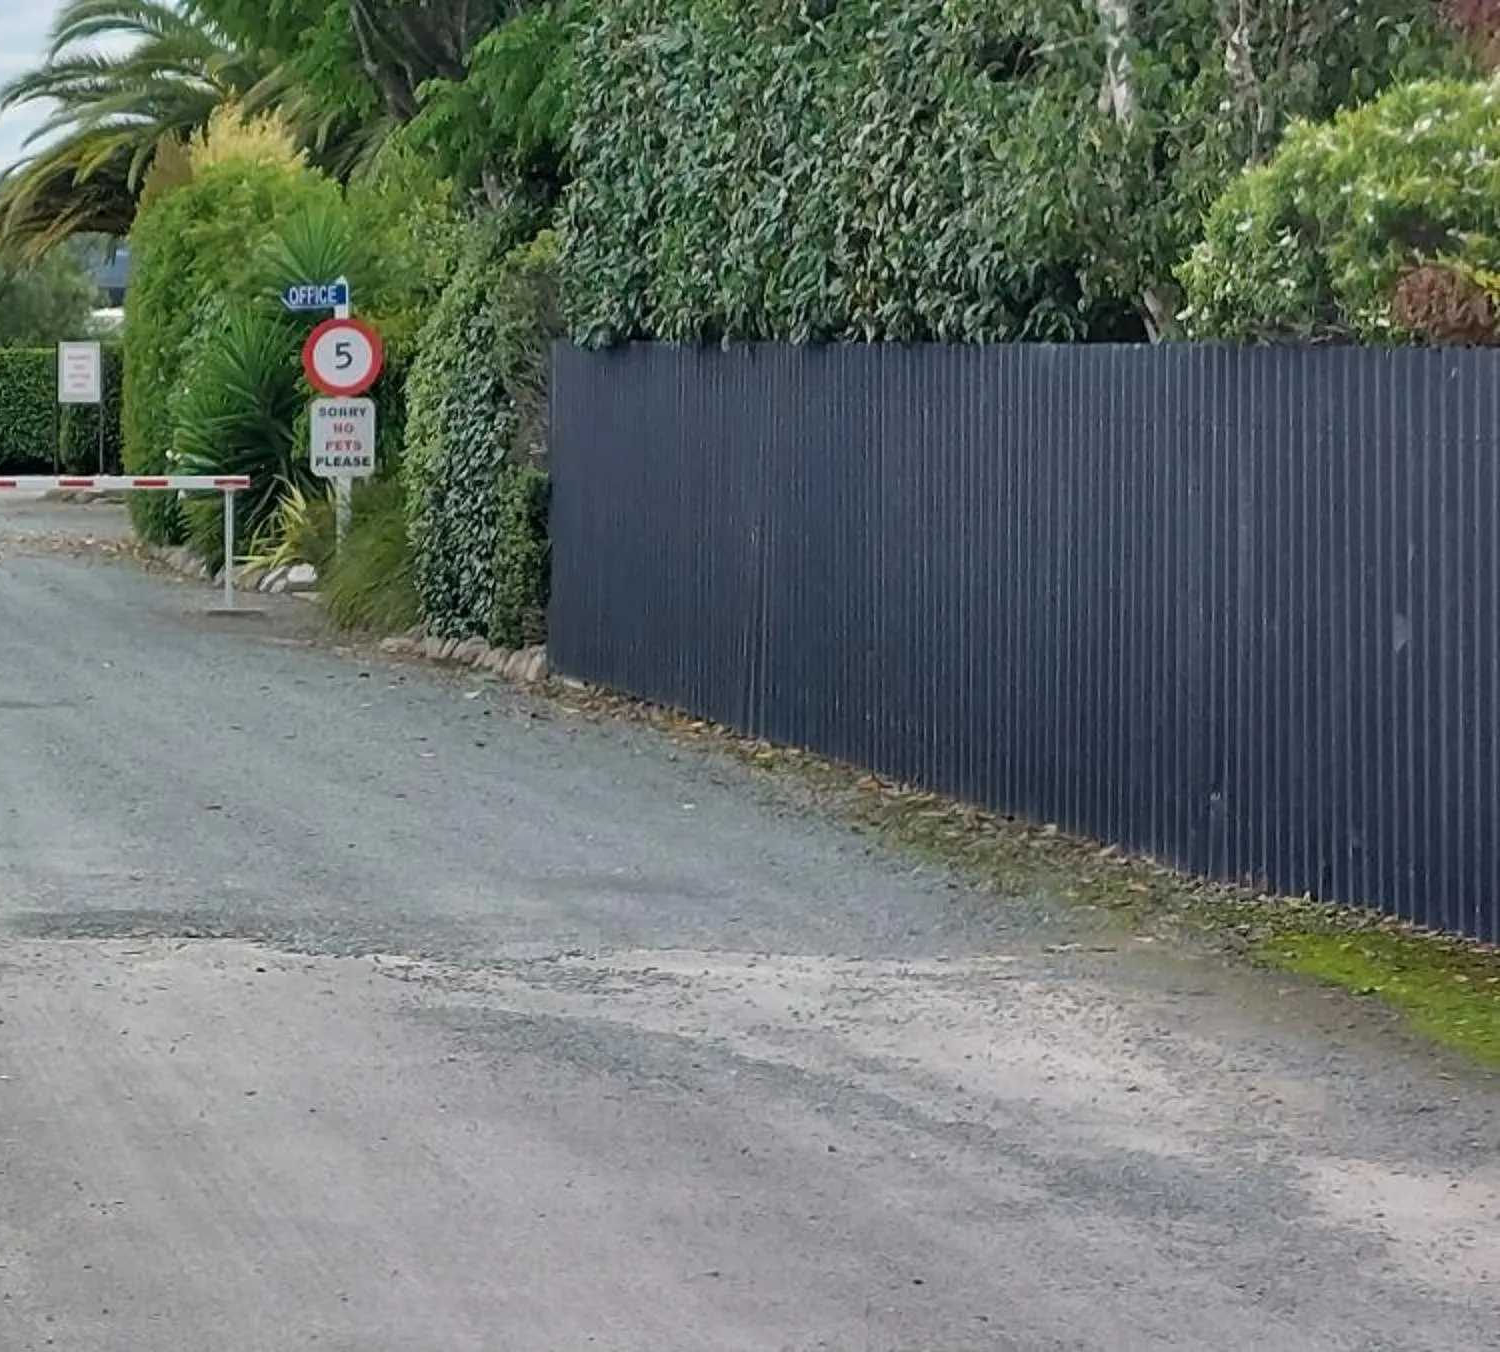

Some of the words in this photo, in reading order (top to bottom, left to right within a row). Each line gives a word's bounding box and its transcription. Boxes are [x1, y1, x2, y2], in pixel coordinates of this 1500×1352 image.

[289, 286, 337, 304] OFFICE
[335, 342, 353, 369] 5
[318, 406, 367, 417] SORRY
[333, 422, 355, 434] NO
[325, 440, 363, 451] PETS
[315, 455, 371, 467] PLEASE
